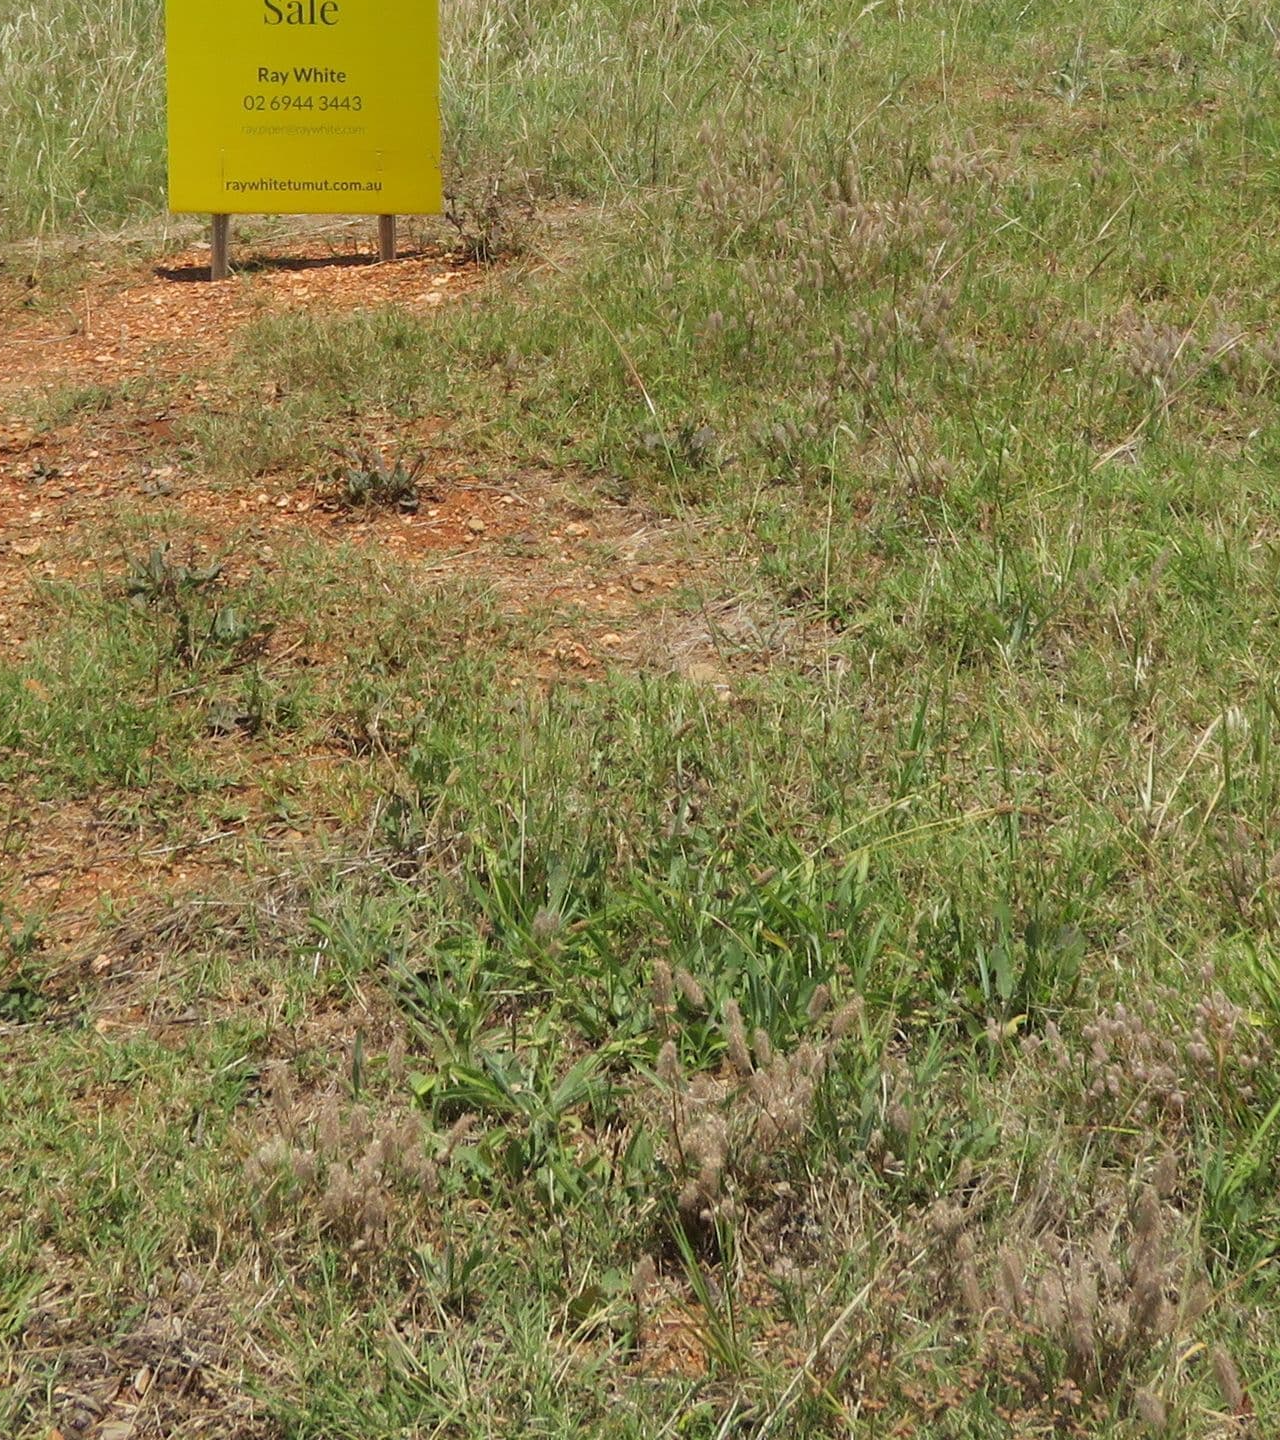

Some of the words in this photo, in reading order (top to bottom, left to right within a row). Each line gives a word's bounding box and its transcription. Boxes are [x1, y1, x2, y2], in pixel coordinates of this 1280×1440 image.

[258, 67, 289, 84] Ray
[293, 67, 346, 83] White
[243, 95, 265, 111] 02
[270, 95, 314, 111] 6944
[319, 95, 362, 111] 3443
[225, 178, 382, 192] raywhitetumut.com.au
